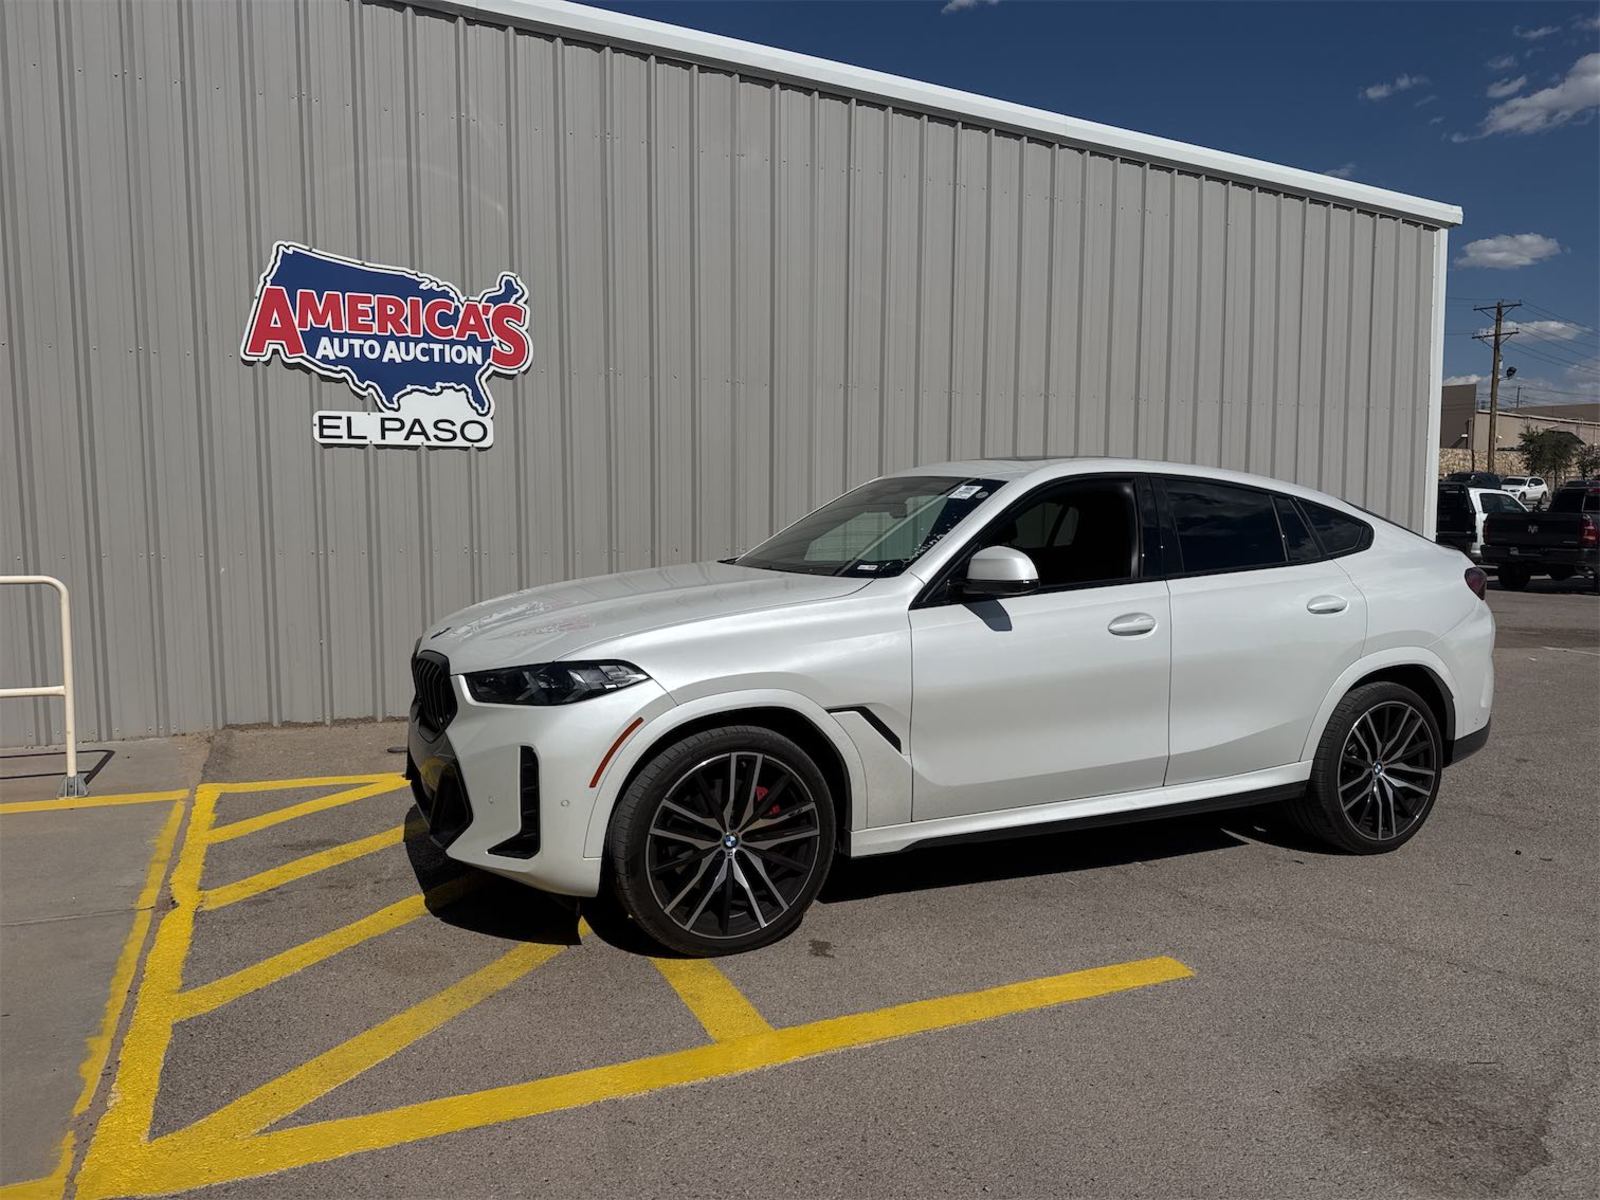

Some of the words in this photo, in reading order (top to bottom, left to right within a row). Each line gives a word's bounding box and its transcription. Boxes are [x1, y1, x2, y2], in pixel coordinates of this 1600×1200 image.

[246, 286, 529, 368] AMERICA'S
[315, 337, 381, 360] AUTO
[382, 339, 483, 365] AUCTION
[317, 415, 368, 440] EL
[380, 418, 488, 443] PASO
